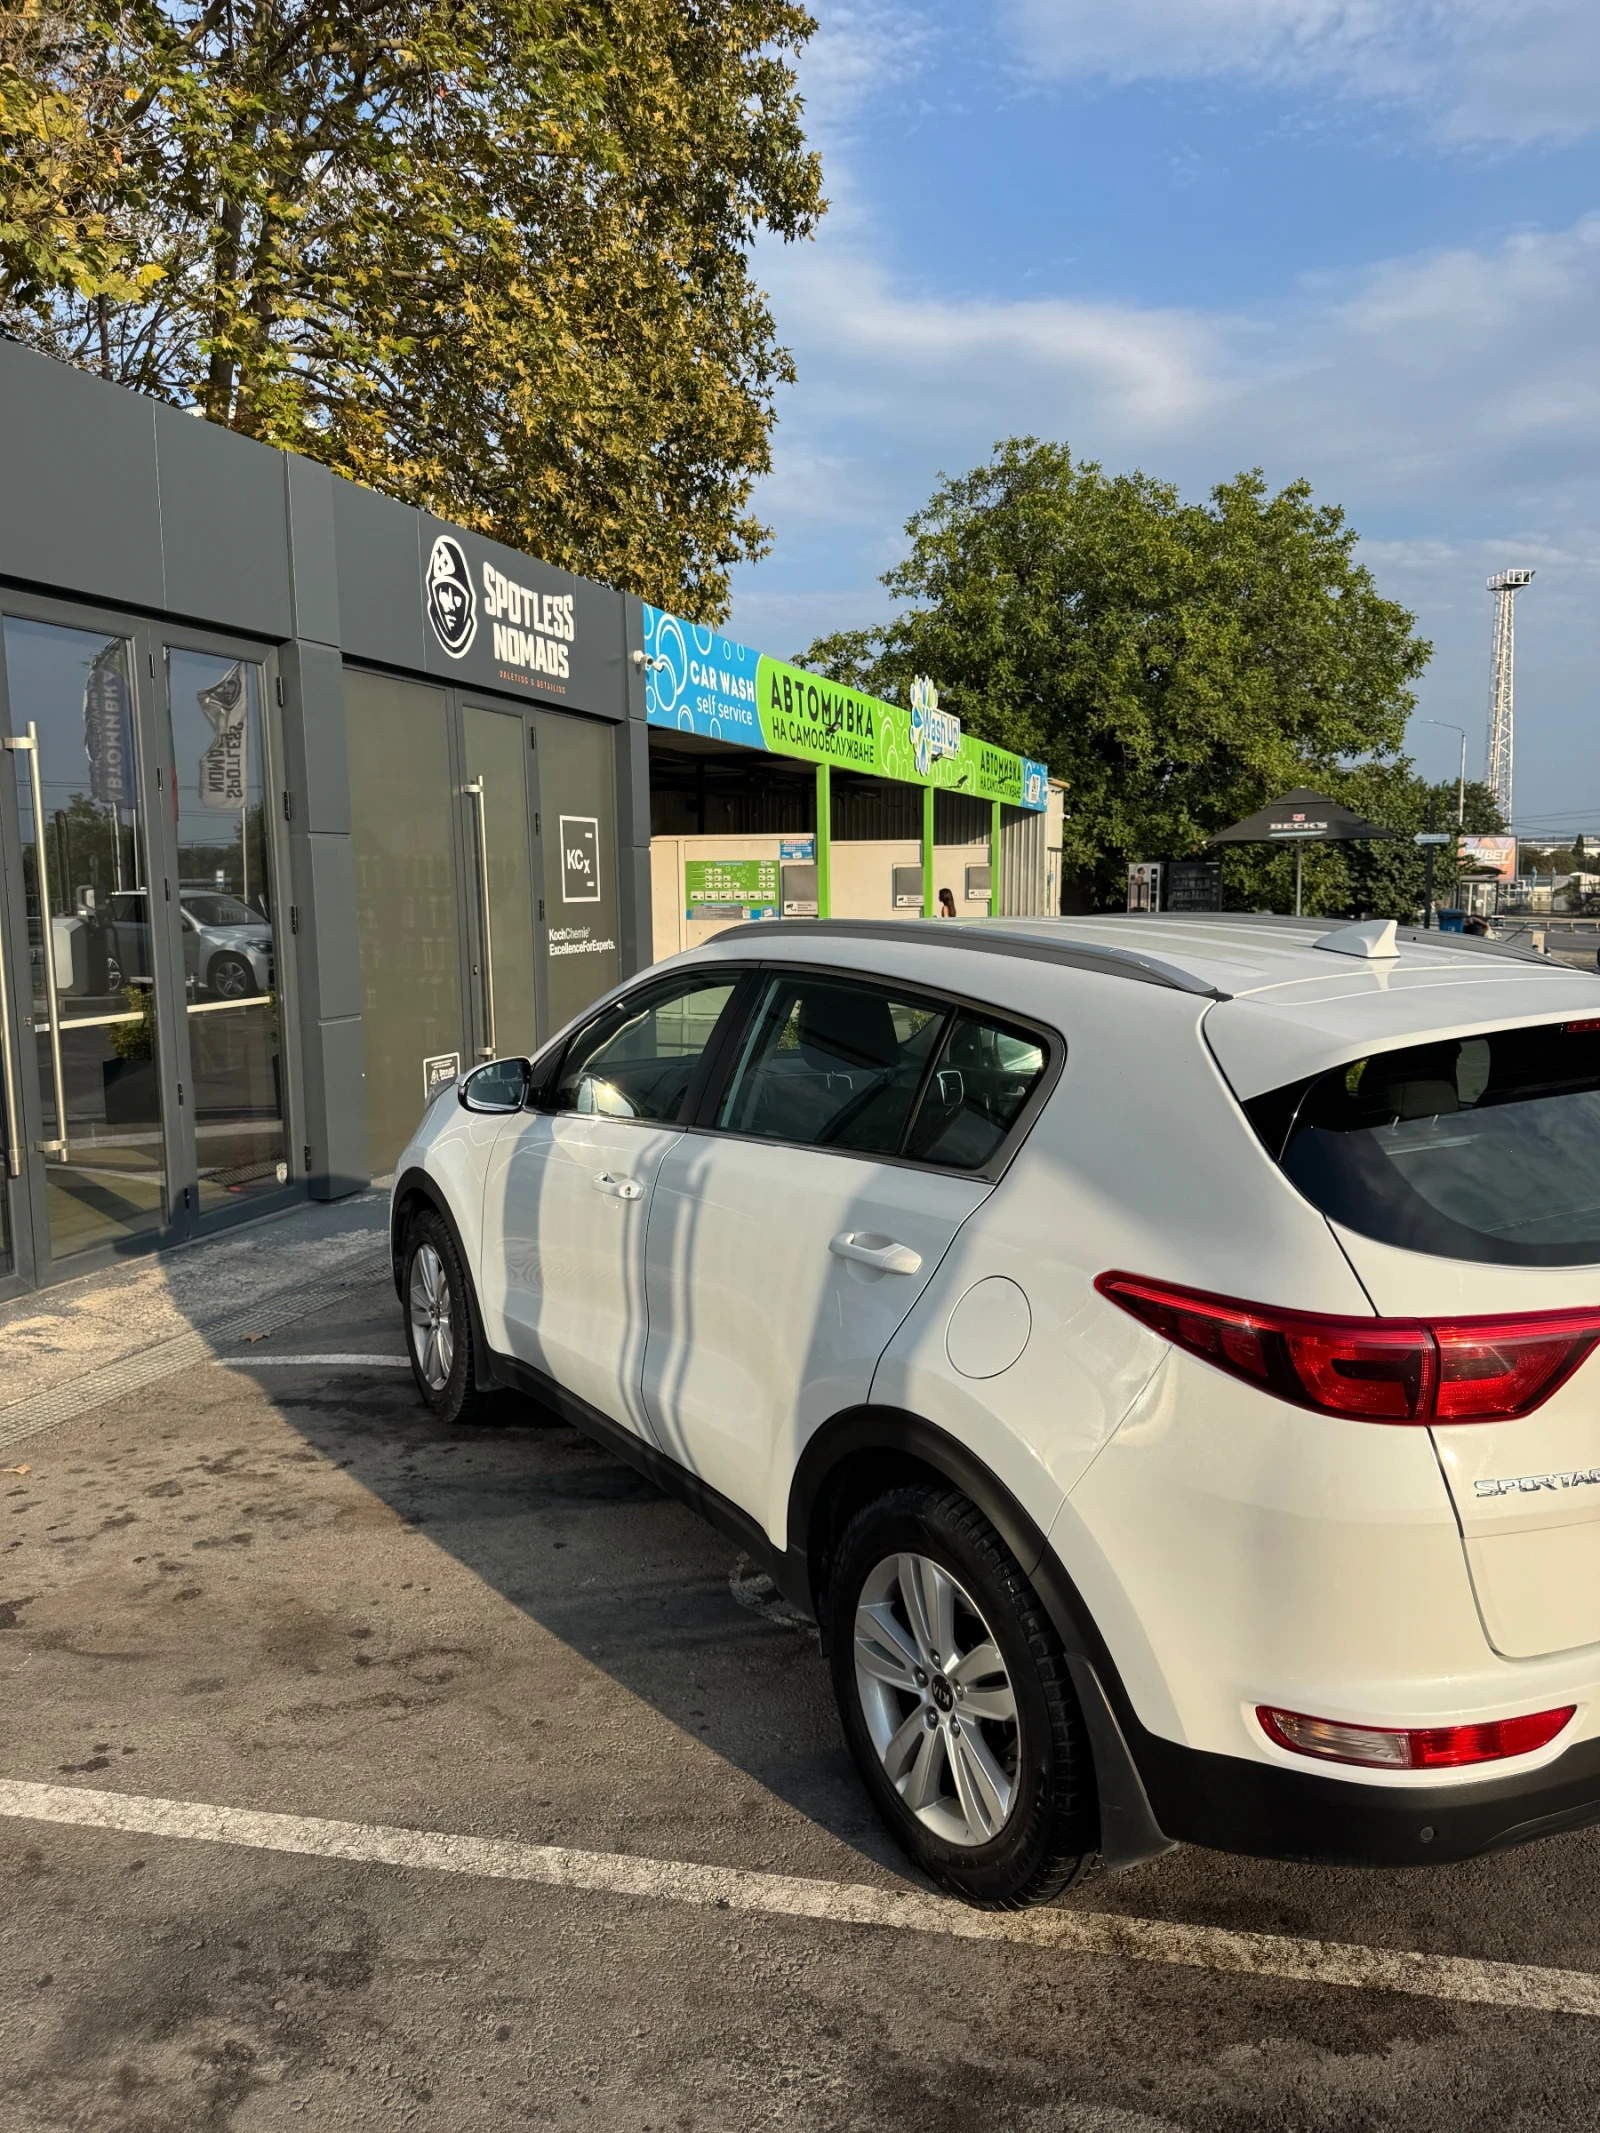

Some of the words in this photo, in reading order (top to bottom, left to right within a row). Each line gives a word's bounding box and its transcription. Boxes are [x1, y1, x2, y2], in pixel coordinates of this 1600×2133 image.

[483, 561, 574, 641] SPOTLESS
[493, 623, 569, 679] NOMADS
[690, 660, 718, 691] CAR
[719, 670, 755, 702] WASH
[771, 671, 874, 739] АВТОМИВКА
[697, 694, 716, 716] self
[718, 703, 753, 726] service
[772, 716, 787, 741] НА
[789, 721, 874, 763] САМООБСЛУЖВАНЕ
